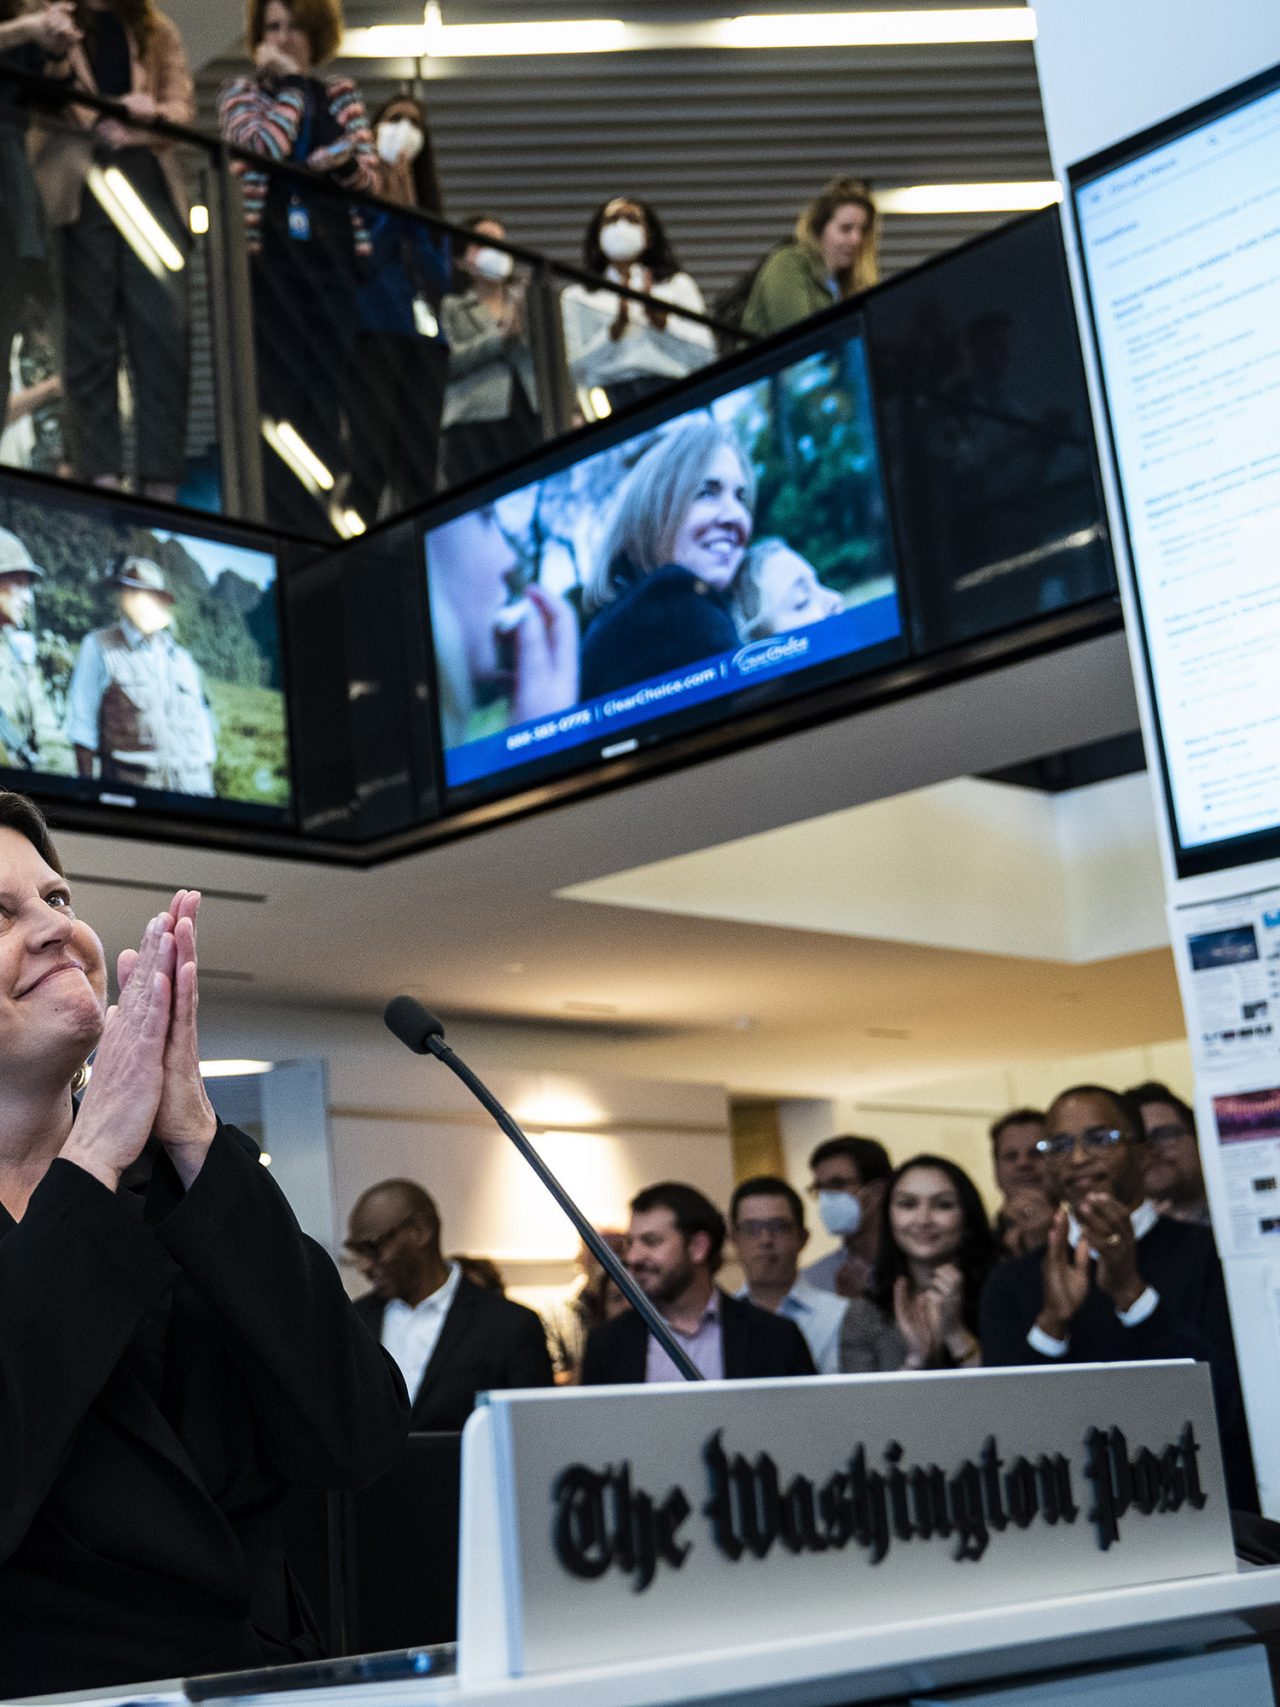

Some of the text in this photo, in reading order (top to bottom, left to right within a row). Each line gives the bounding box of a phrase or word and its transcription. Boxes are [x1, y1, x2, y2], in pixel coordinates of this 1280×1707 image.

[603, 667, 716, 717] ClearChoice.com
[552, 1420, 1208, 1594] The Washington Post
